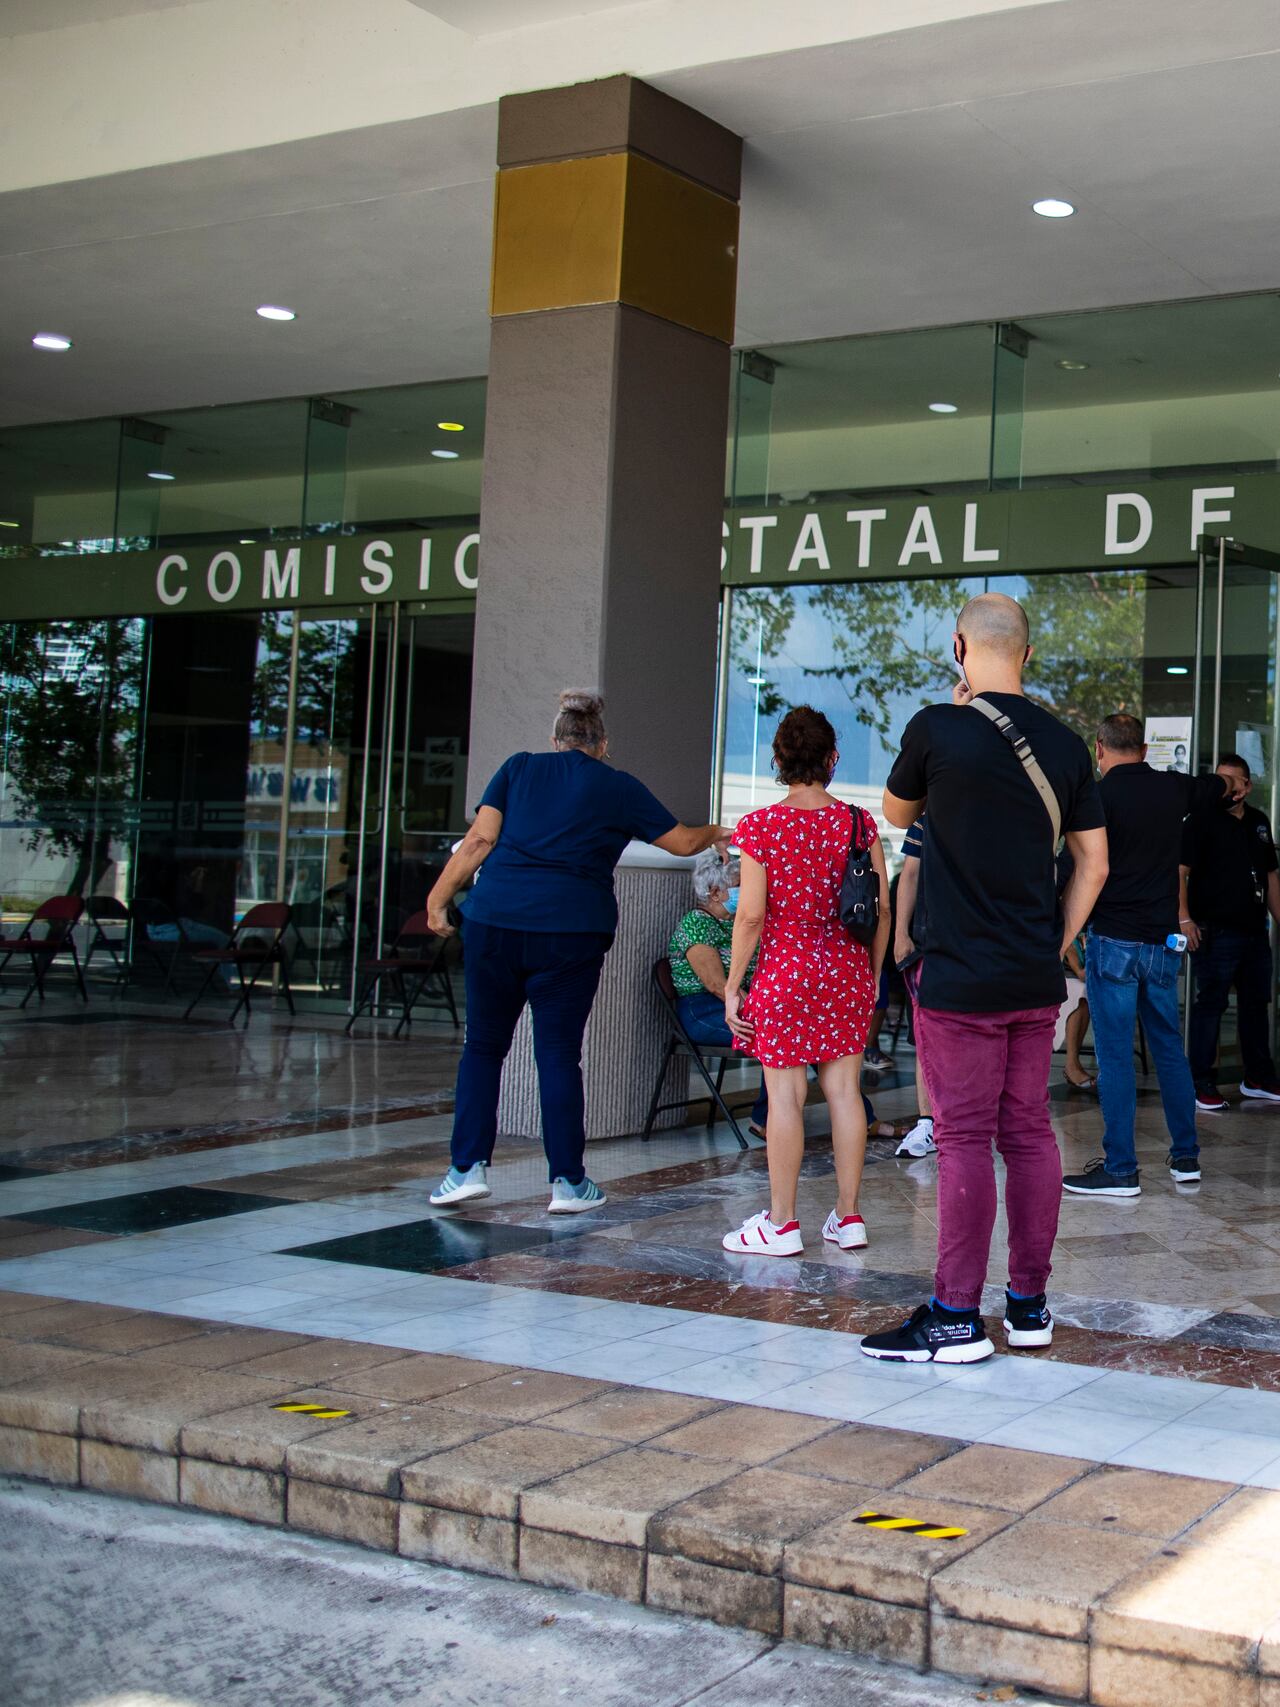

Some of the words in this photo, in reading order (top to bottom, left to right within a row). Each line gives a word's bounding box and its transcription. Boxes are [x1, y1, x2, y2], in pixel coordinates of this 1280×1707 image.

[154, 533, 482, 606] COMISIO
[721, 502, 1000, 575] TATAL
[1104, 485, 1237, 557] DE
